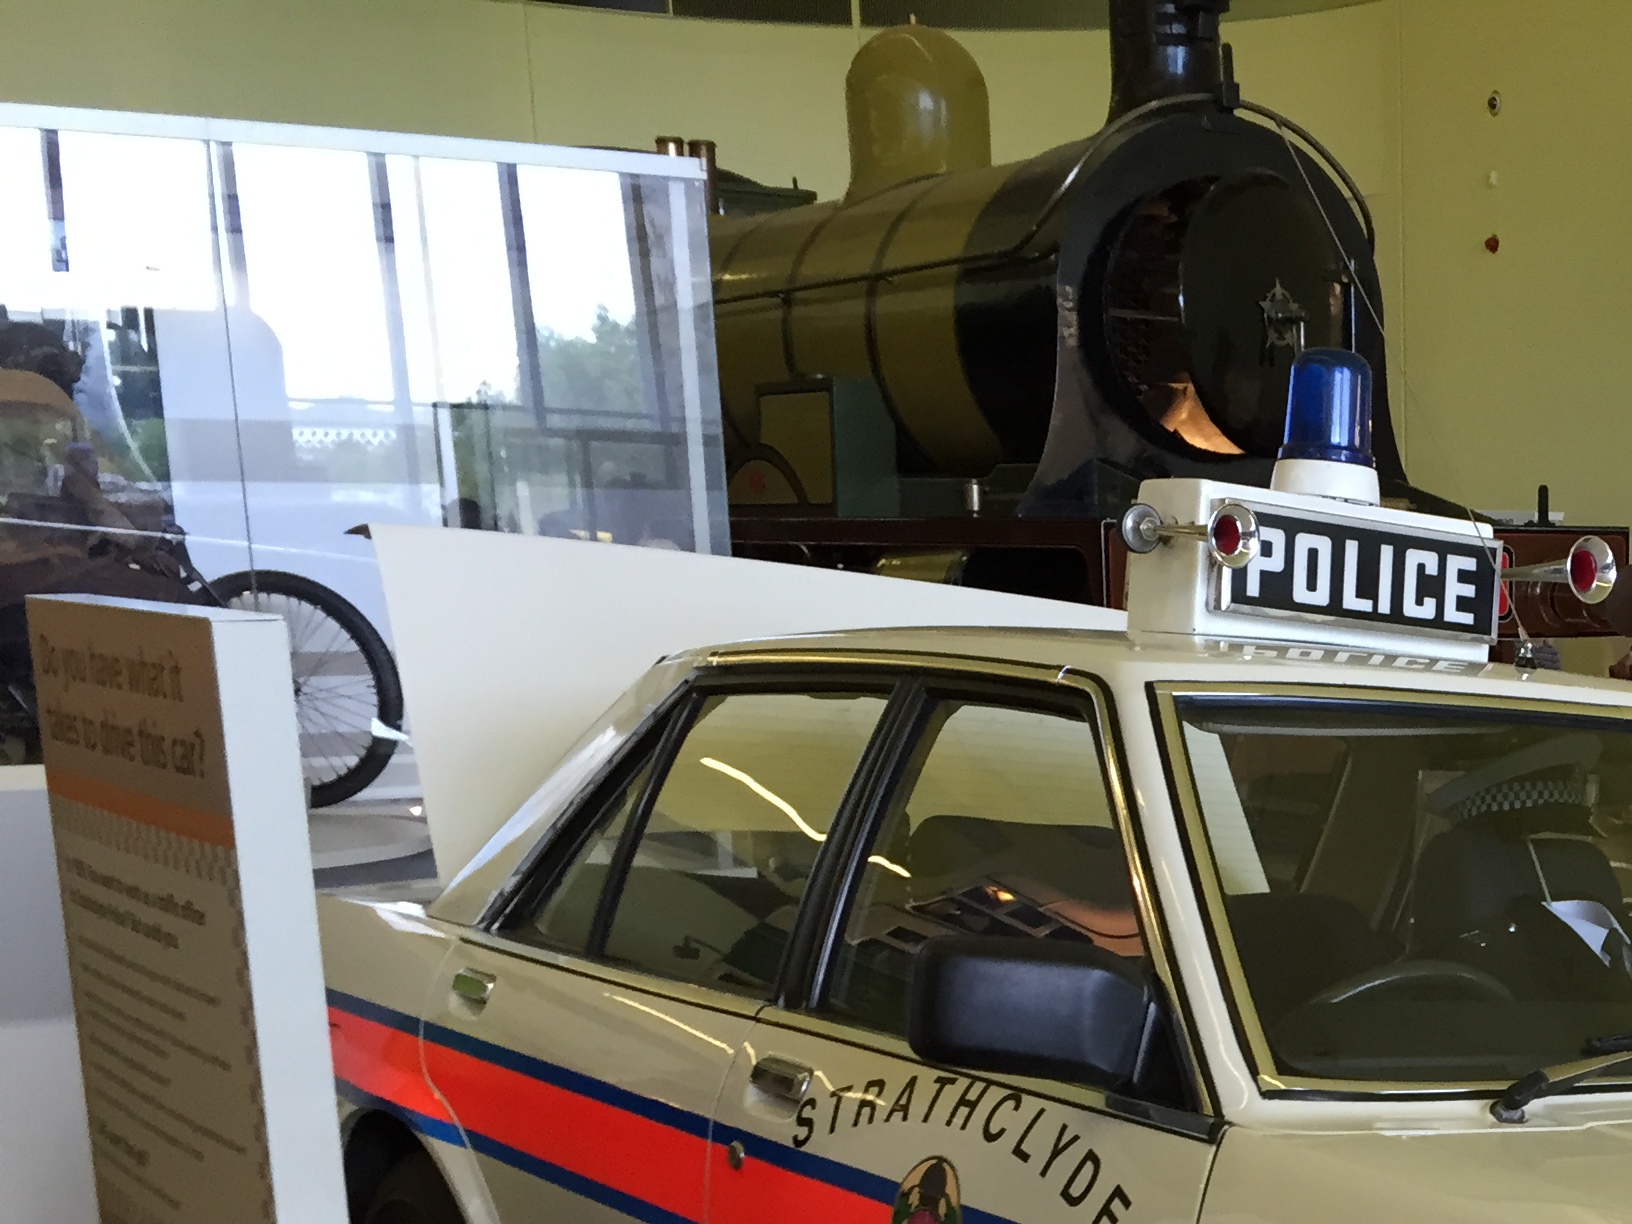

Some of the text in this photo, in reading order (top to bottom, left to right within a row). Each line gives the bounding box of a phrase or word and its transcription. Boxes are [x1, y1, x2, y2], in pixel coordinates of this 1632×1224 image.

[1246, 525, 1477, 626] POLICE
[61, 648, 88, 694] you
[171, 728, 206, 779] car?
